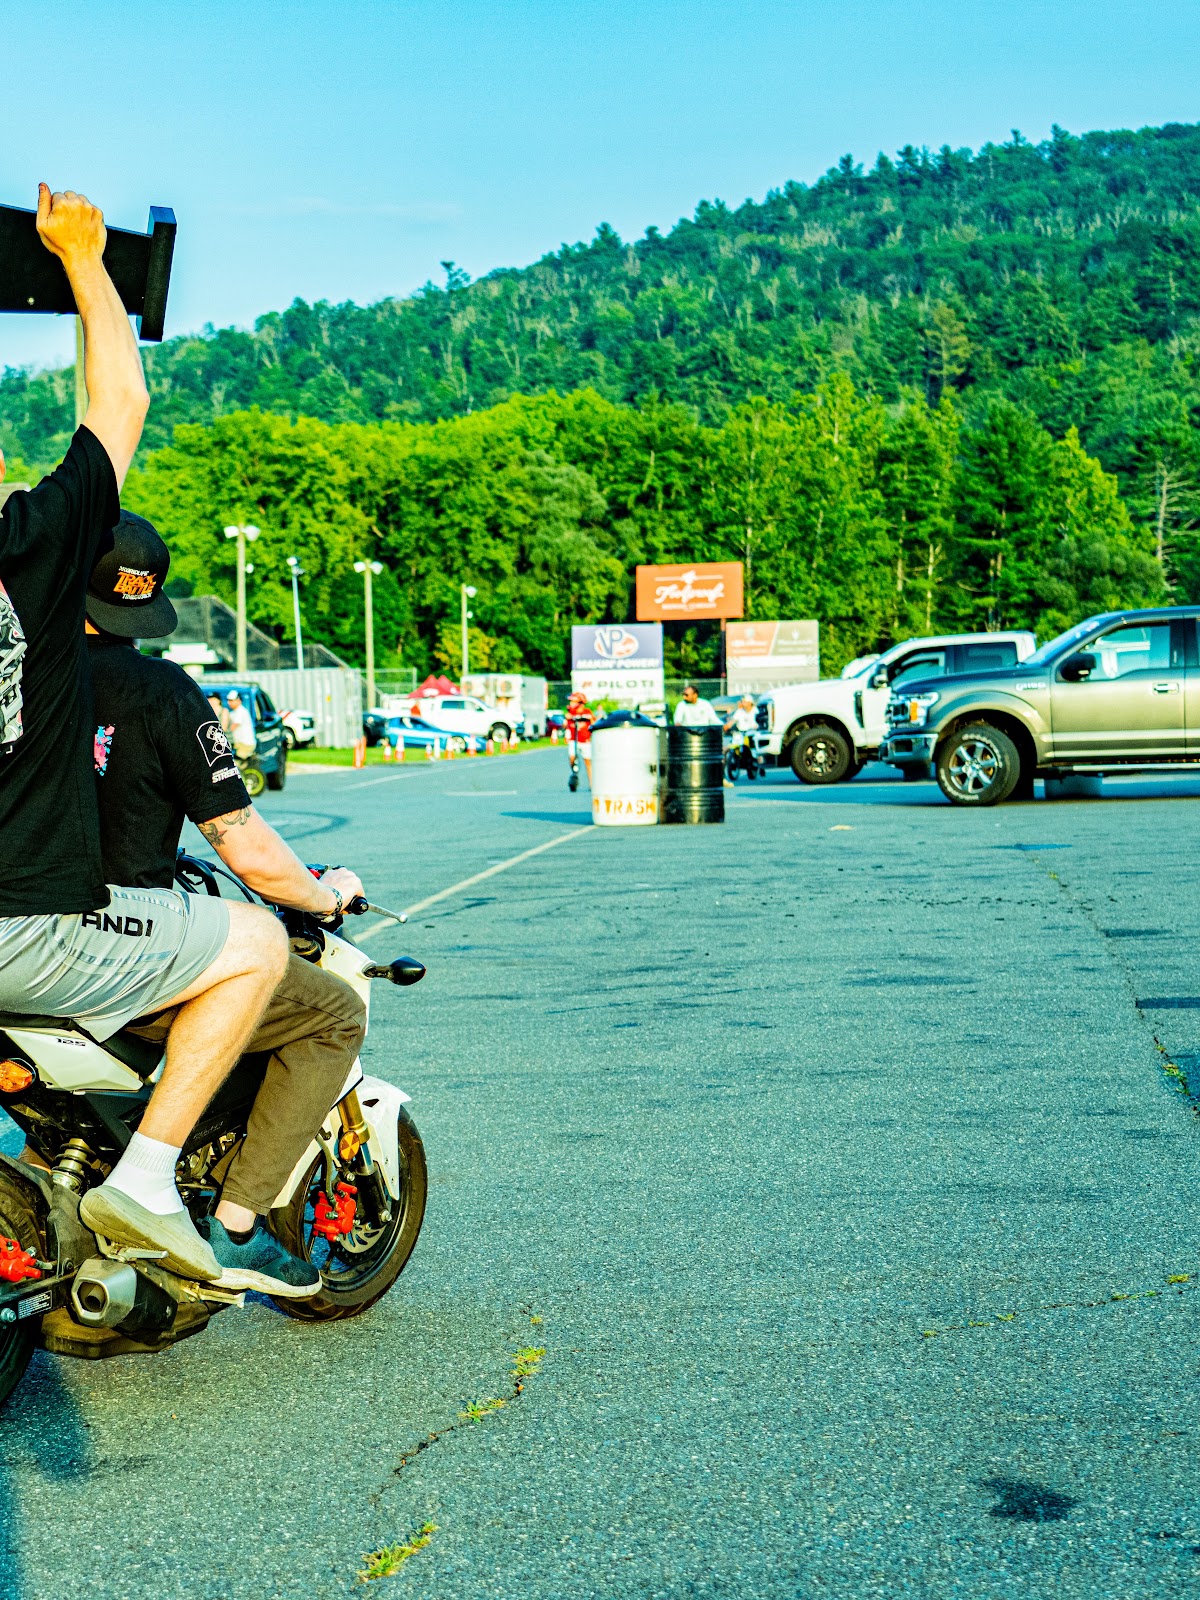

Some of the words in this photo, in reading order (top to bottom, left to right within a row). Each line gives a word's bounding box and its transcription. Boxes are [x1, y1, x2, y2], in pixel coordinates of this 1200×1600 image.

[116, 571, 157, 586] TRACK
[113, 582, 155, 595] BATTLE
[598, 628, 624, 656] VP
[597, 680, 655, 688] PILOTI
[605, 799, 656, 815] TRASH
